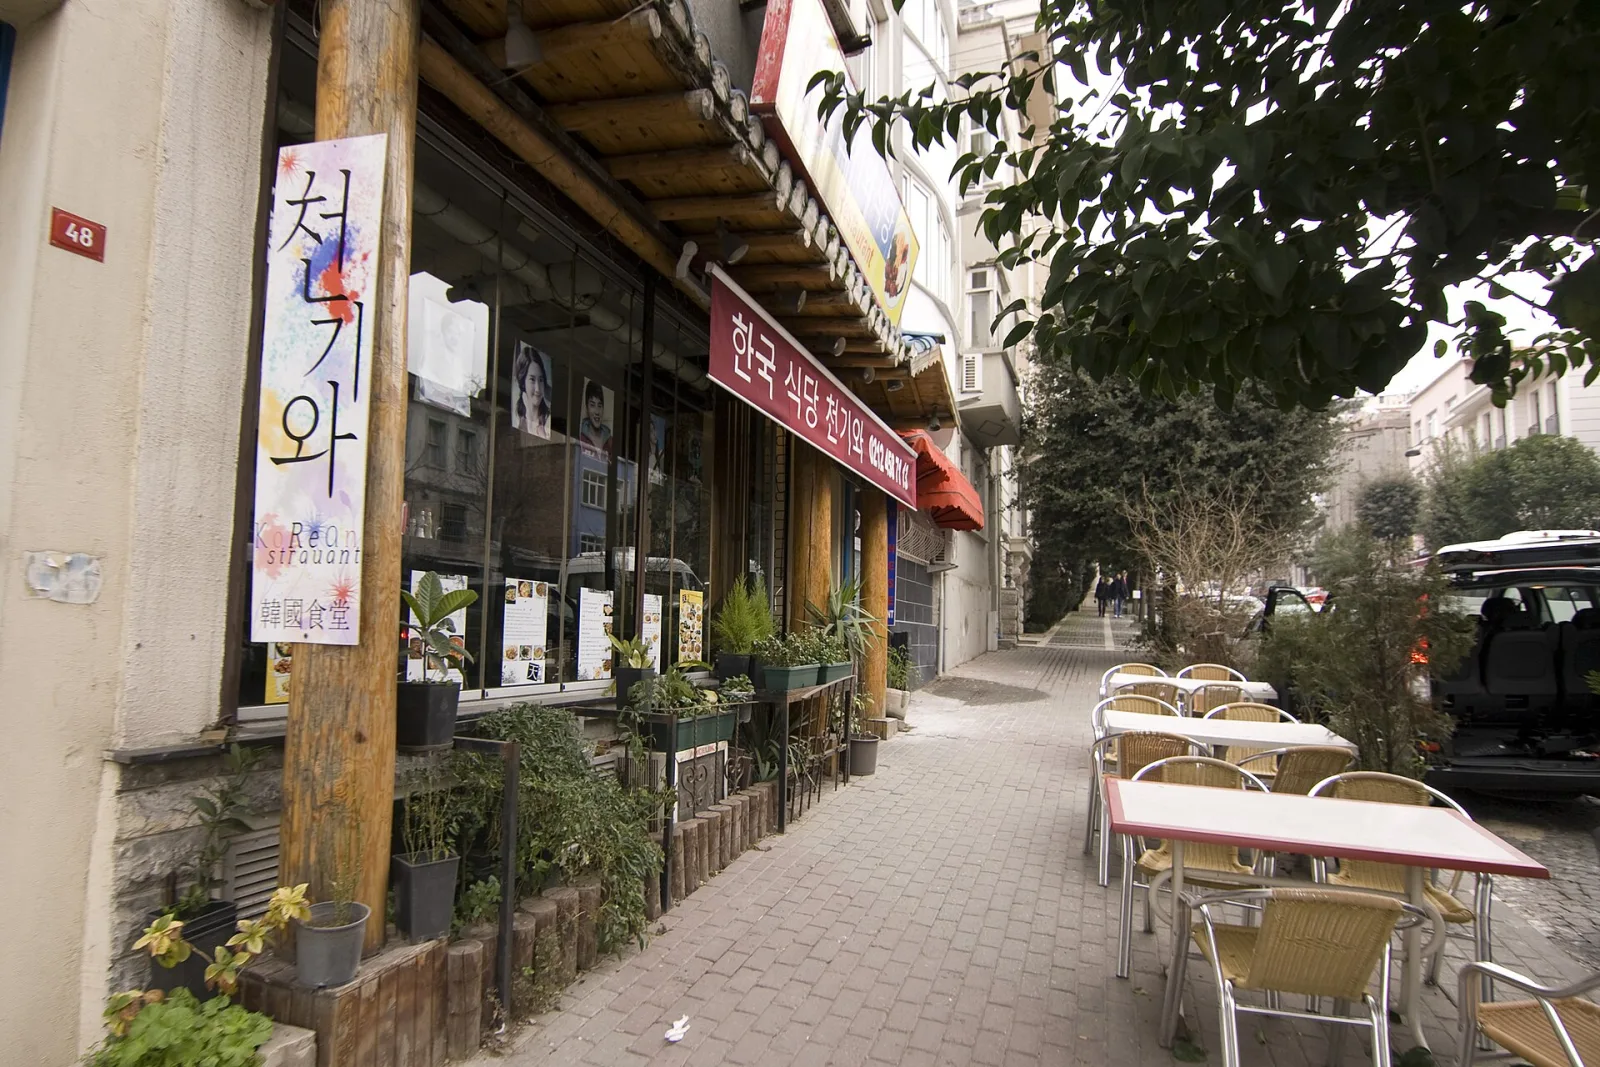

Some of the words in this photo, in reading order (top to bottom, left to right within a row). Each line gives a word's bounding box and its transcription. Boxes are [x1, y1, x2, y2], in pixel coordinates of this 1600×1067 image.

[65, 221, 94, 248] 48
[270, 169, 364, 498] 천기와
[731, 312, 777, 400] 한국
[784, 360, 820, 429] 식당
[825, 393, 864, 463] 천기와
[868, 434, 884, 473] 0212
[259, 597, 351, 631] 韓國食堂
